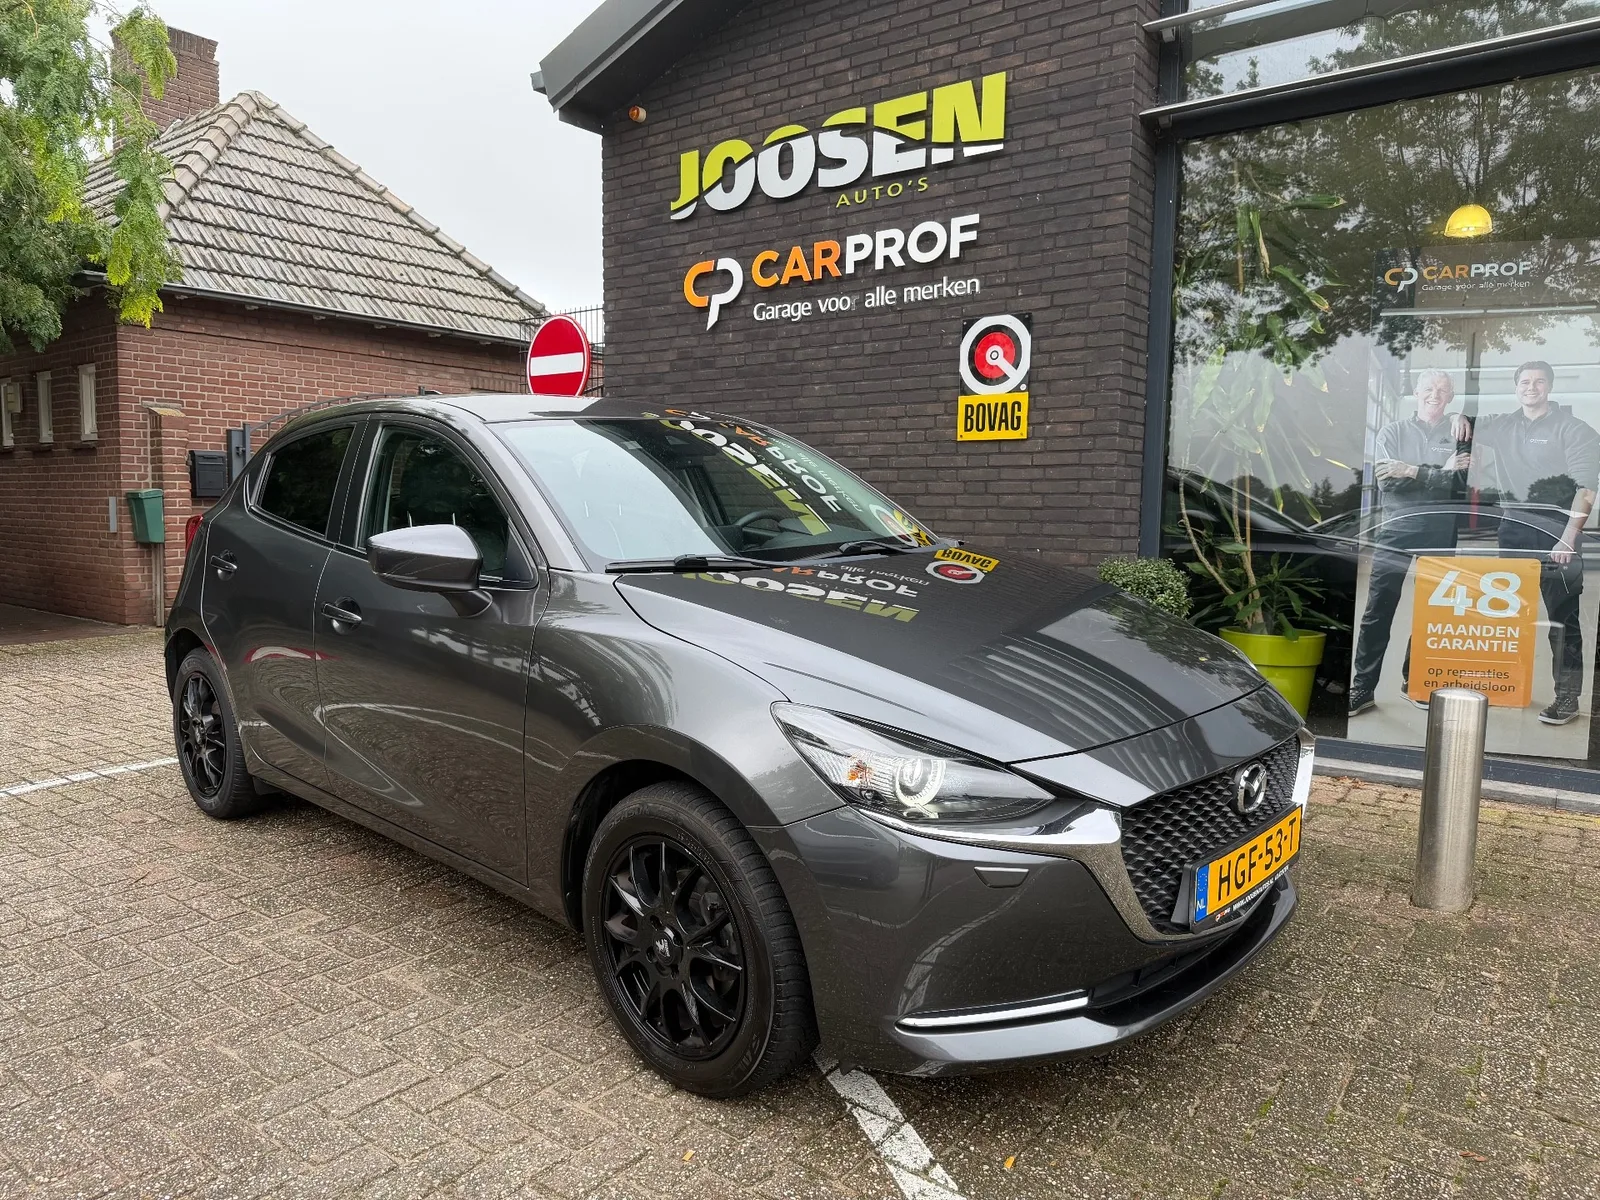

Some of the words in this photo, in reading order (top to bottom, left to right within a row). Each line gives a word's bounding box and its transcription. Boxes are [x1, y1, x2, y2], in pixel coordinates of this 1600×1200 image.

[670, 71, 1007, 220] JOOSEN
[835, 177, 930, 208] AUTO'S
[751, 213, 980, 288] CARPROF
[1422, 261, 1532, 280] CARPROF
[753, 300, 813, 321] Garage
[817, 293, 860, 314] voor
[864, 284, 897, 308] alle
[903, 275, 980, 303] merken
[1421, 283, 1452, 292] Garage
[1455, 282, 1476, 291] voor
[1478, 280, 1494, 289] alle
[1496, 279, 1531, 289] merken
[963, 400, 1022, 433] BOVAG
[1427, 571, 1522, 618] 48
[1427, 623, 1520, 638] MAANDEN
[1426, 637, 1518, 653] GARANTIE
[1423, 679, 1439, 688] en
[1442, 678, 1516, 693] arbeidsloon
[1427, 667, 1443, 679] op
[1446, 667, 1510, 680] reparaties
[1217, 817, 1297, 902] HGF-53-T
[1196, 898, 1206, 912] NL
